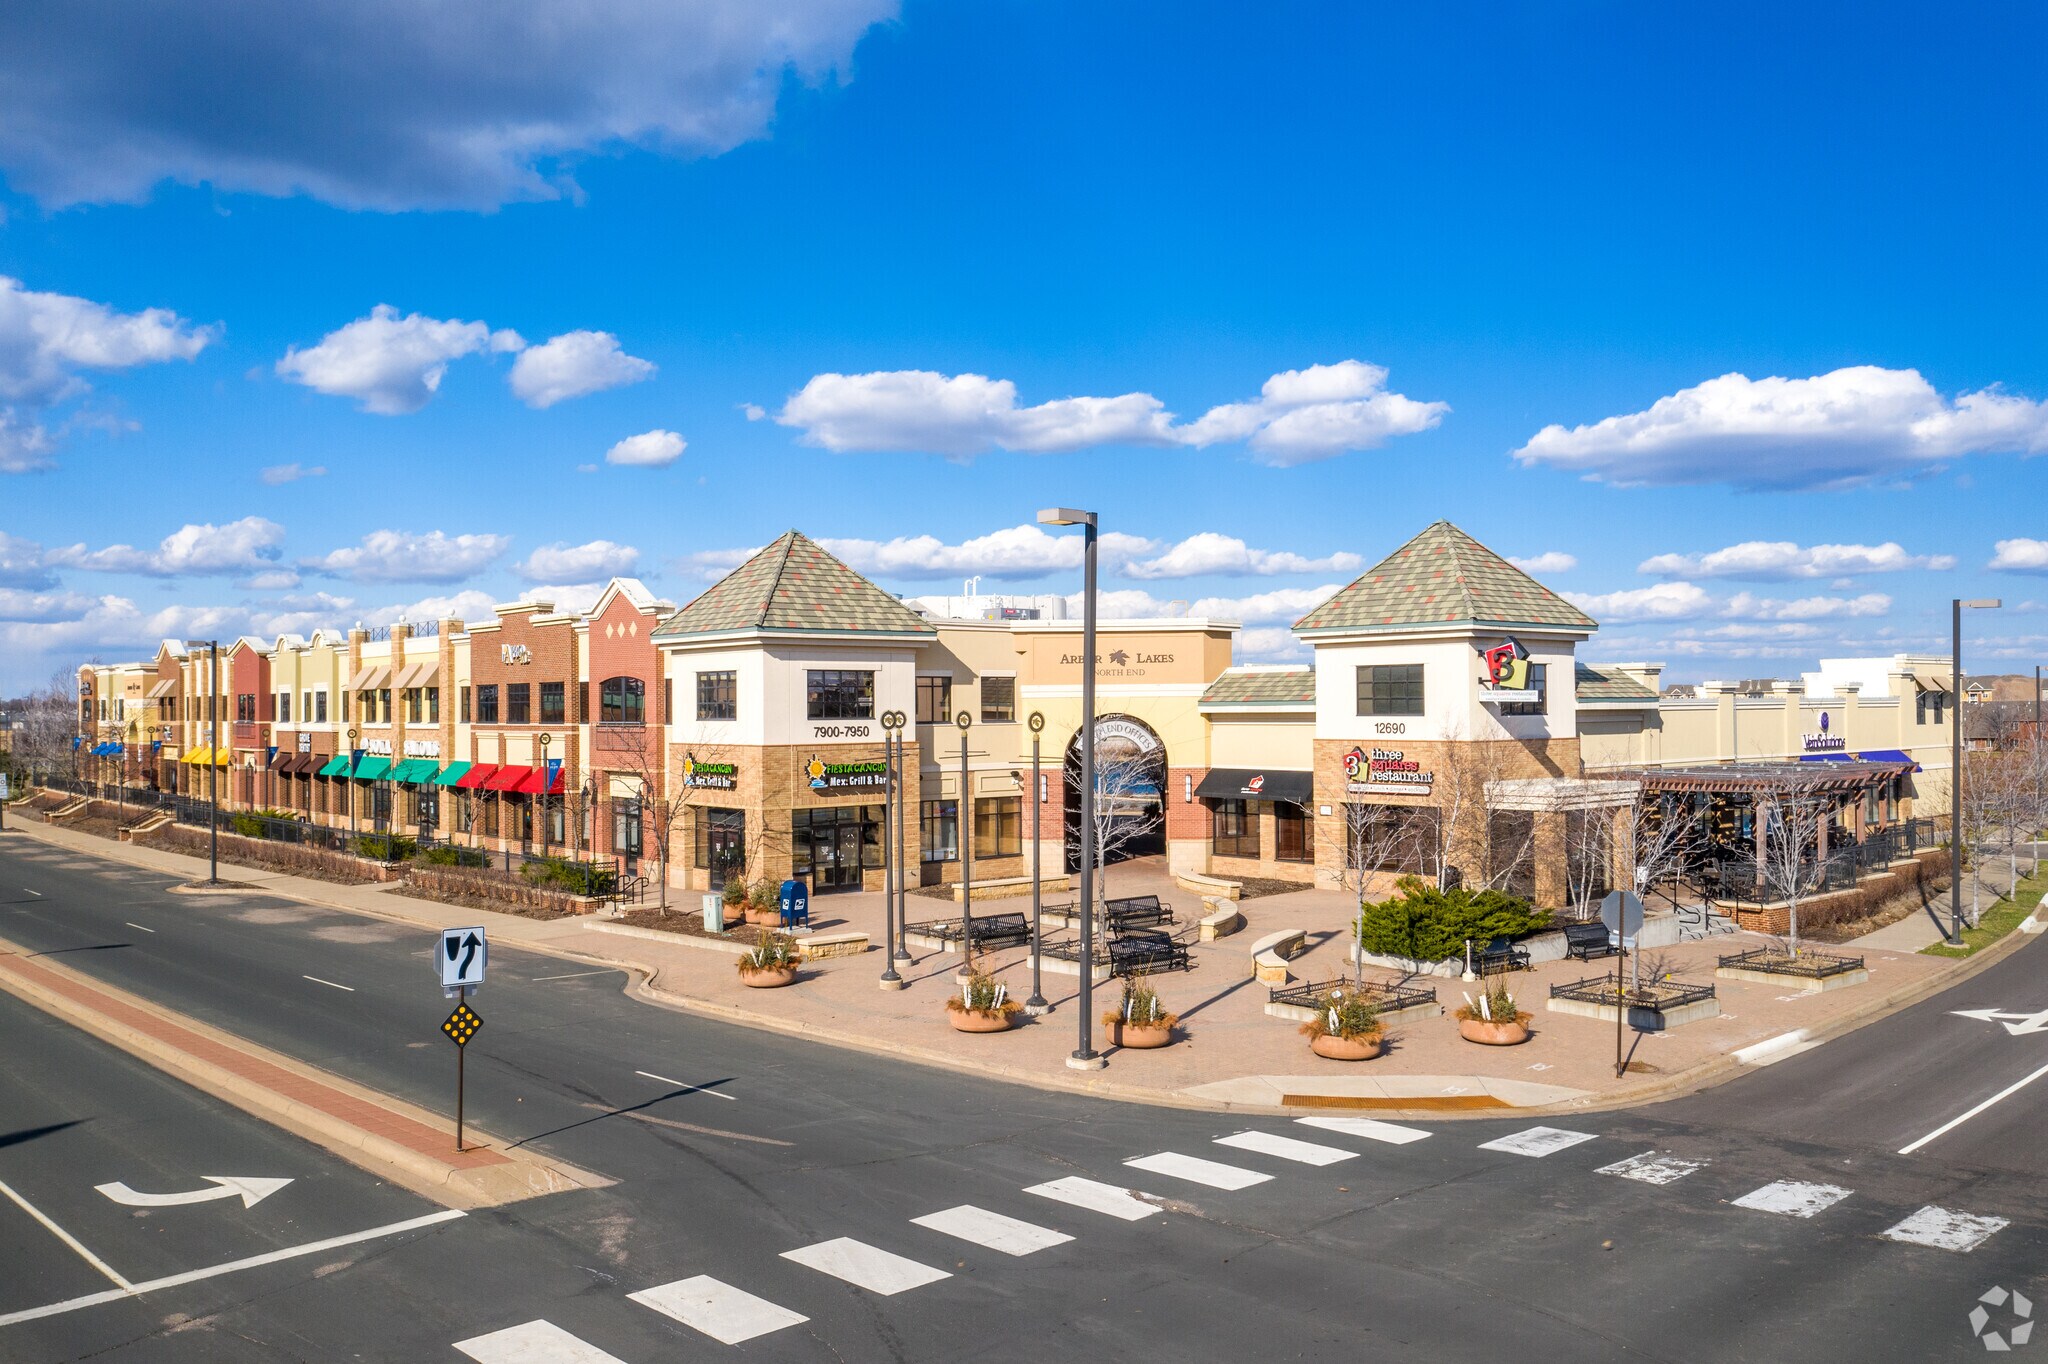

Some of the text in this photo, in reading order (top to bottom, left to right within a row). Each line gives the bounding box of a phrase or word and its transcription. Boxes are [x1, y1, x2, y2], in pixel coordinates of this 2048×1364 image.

[1060, 653, 1102, 664] ARBR
[1492, 650, 1515, 681] 3
[1126, 668, 1146, 676] END
[814, 726, 870, 738] 7900-7950
[1374, 722, 1406, 734] 12690
[1107, 724, 1123, 733] END
[1124, 726, 1153, 749] OFFICES
[1371, 748, 1402, 760] three
[827, 764, 853, 774] FIESTA
[1345, 756, 1359, 775] 3
[1371, 760, 1418, 772] squares
[849, 776, 866, 785] Grill
[867, 776, 873, 785] &
[874, 775, 887, 784] Bar
[1372, 771, 1433, 782] restaurant
